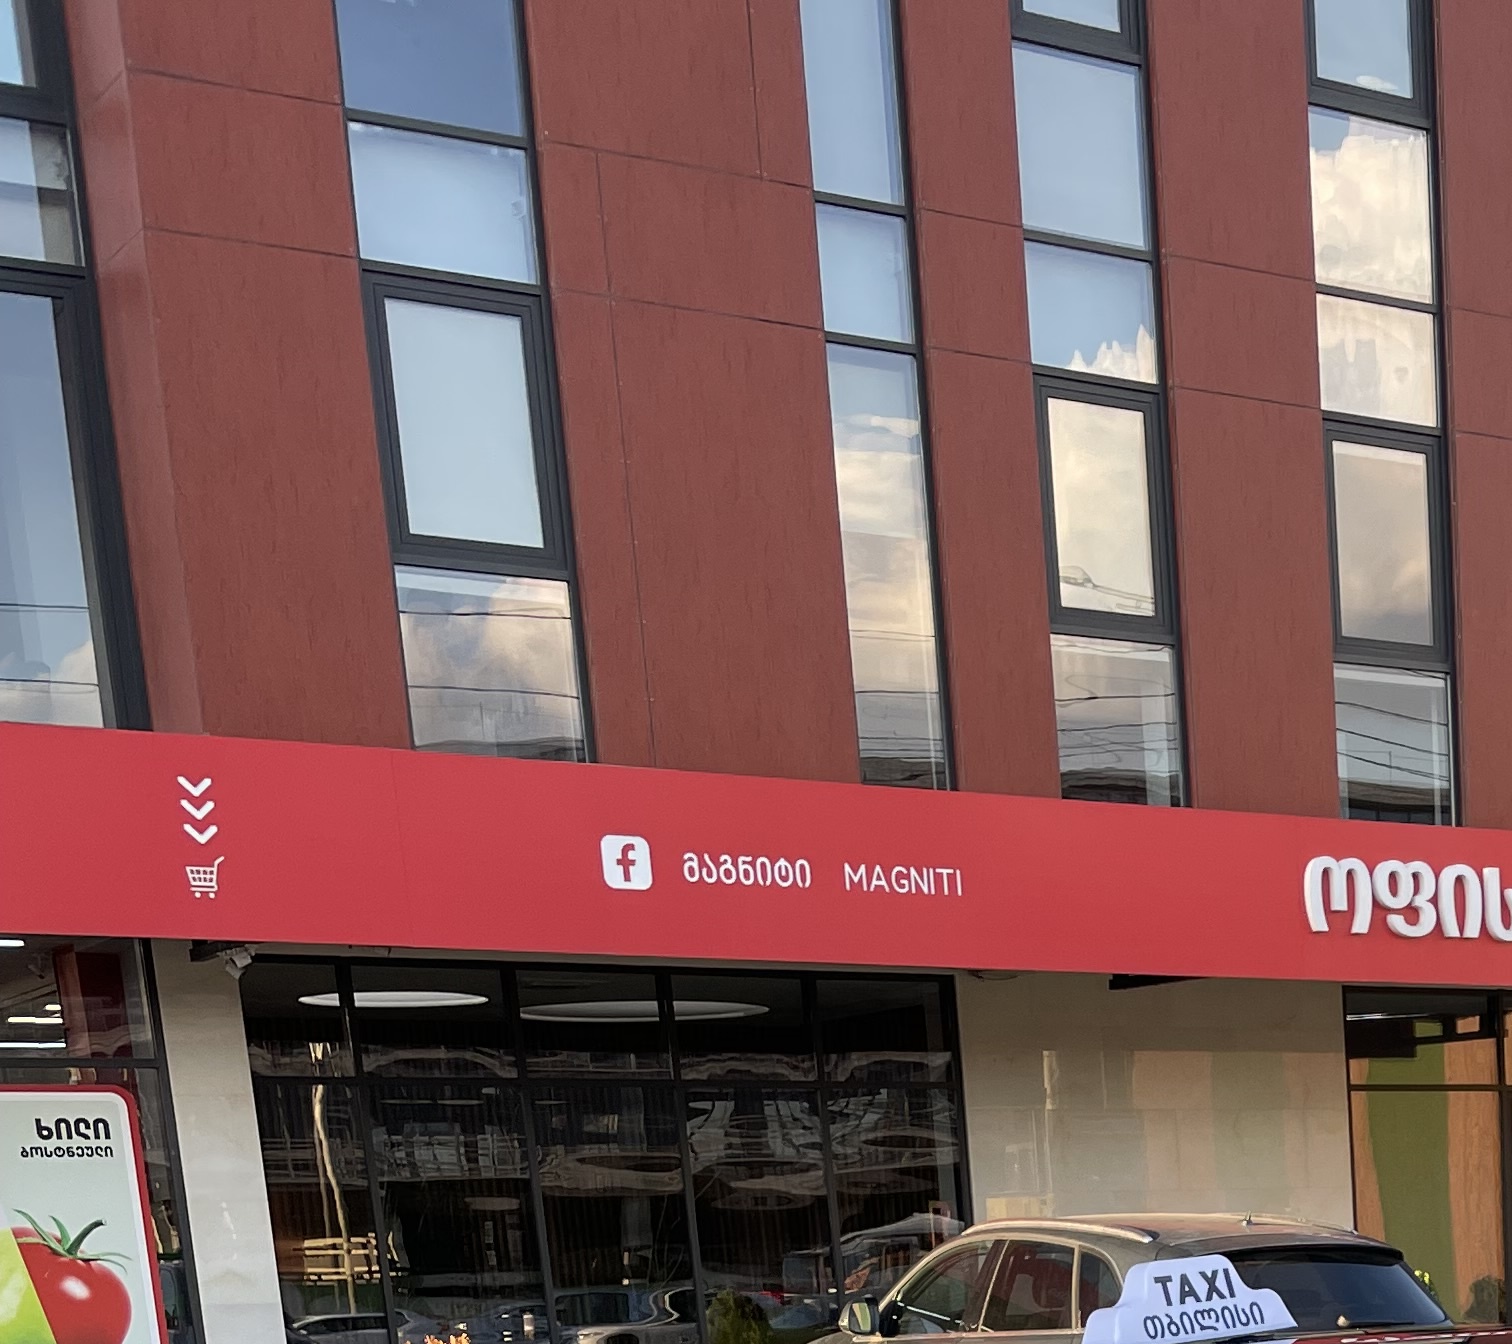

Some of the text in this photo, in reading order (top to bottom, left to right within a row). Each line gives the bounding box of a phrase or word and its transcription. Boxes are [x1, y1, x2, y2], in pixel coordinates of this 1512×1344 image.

[682, 852, 811, 888] მაგნიტი
[843, 862, 962, 897] MAGNITI
[1153, 1268, 1236, 1307] TAXI
[1143, 1301, 1265, 1340] თბილისი
